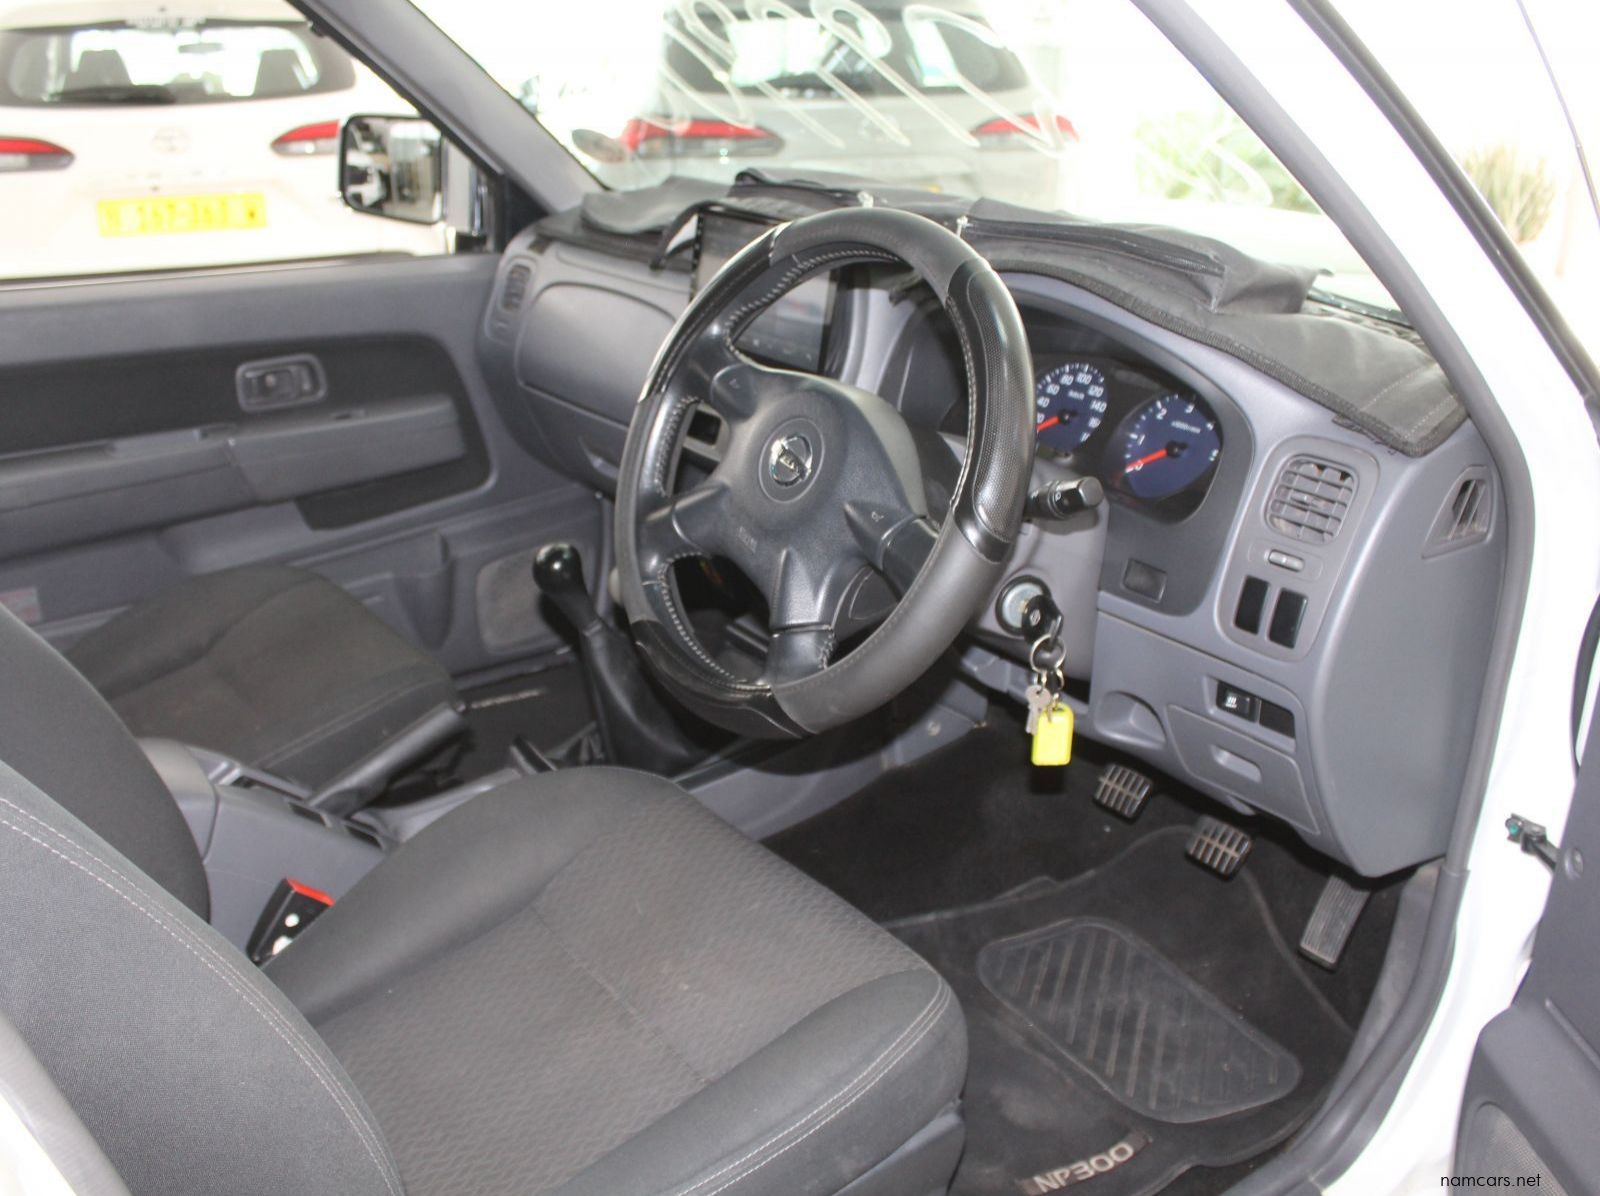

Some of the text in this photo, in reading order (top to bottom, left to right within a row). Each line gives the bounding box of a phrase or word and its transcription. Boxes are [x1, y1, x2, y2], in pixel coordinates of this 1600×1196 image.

[1060, 374, 1074, 386] 80
[1076, 372, 1092, 385] 100
[1090, 399, 1107, 413] 140
[1156, 408, 1167, 420] 2
[1033, 1142, 1134, 1193] NP300
